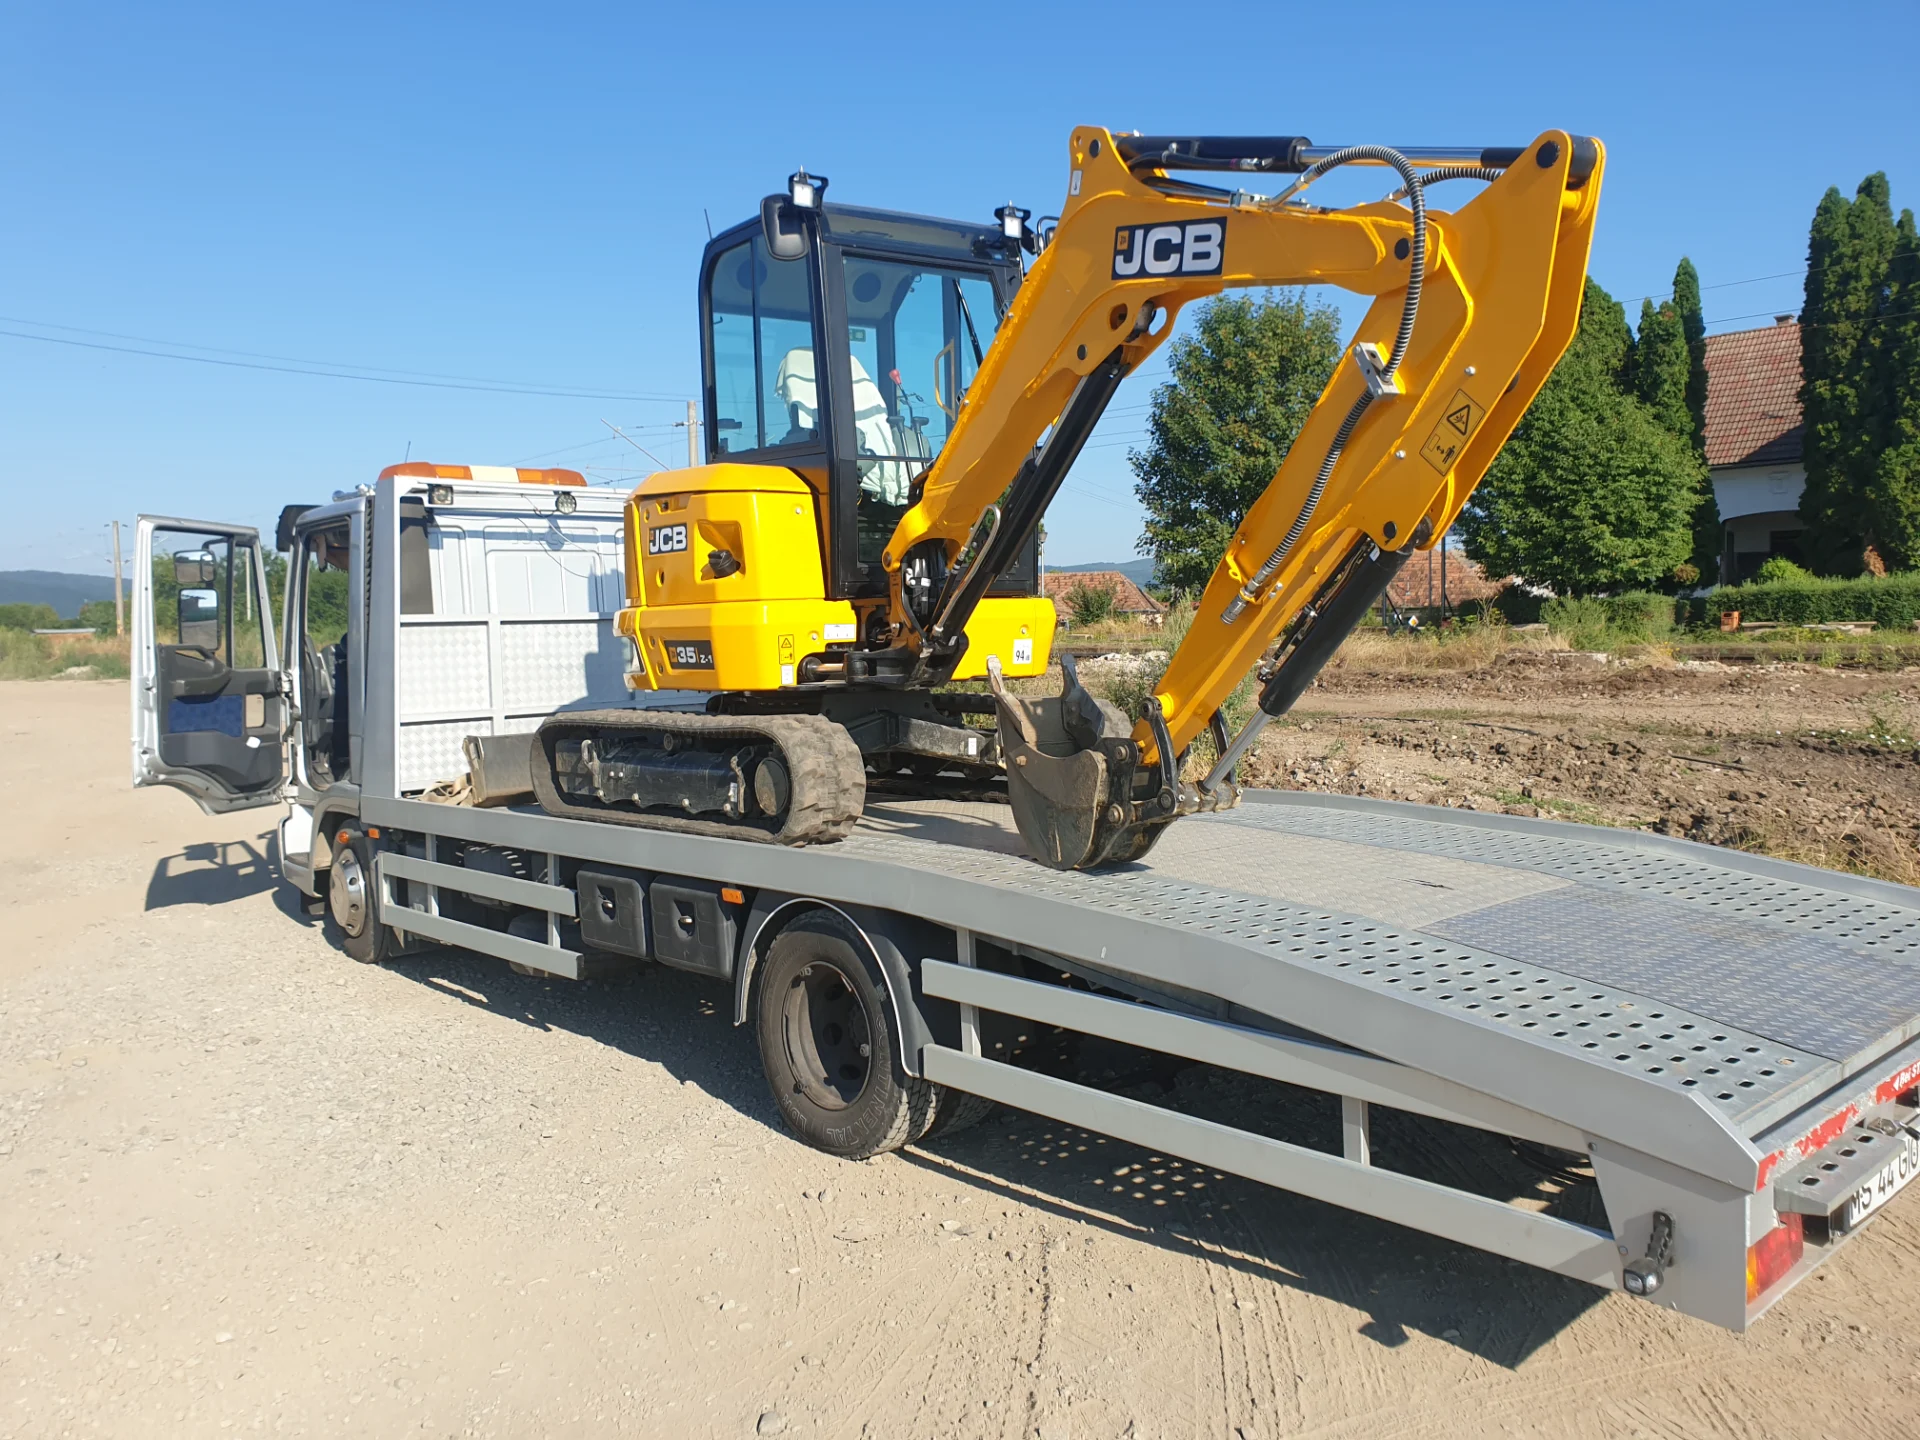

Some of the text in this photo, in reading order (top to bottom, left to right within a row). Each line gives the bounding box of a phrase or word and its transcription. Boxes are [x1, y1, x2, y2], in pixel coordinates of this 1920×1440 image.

[1114, 222, 1223, 276] JCB
[649, 525, 688, 554] JCB
[676, 646, 697, 664] 35
[1015, 650, 1025, 661] 94
[1877, 1163, 1894, 1196] 44
